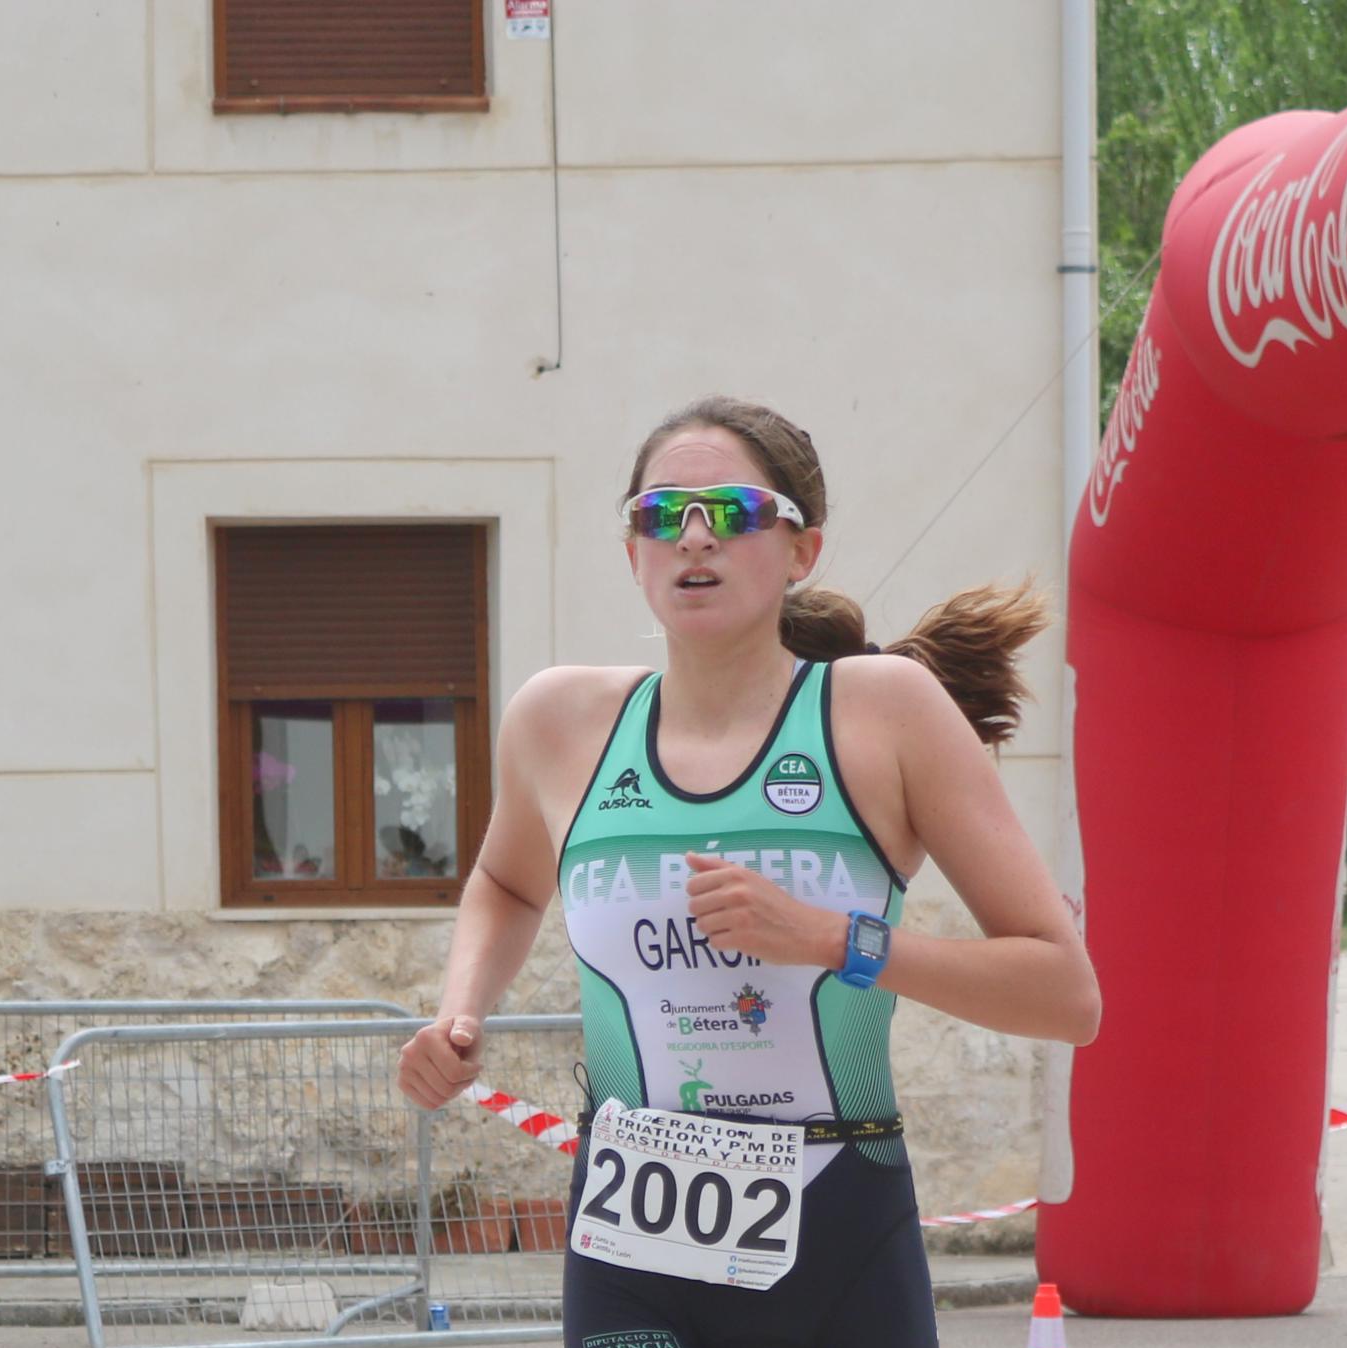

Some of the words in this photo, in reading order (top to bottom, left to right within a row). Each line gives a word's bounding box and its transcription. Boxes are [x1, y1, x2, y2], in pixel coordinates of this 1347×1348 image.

[779, 760, 808, 774] CEA
[777, 786, 810, 797] BÉTERA
[567, 853, 637, 903] CEA
[660, 999, 727, 1016] ajuntament
[678, 1016, 739, 1035] Bétera
[703, 1091, 795, 1107] PULGADAS
[617, 1117, 704, 1144] TRIATLON
[712, 1138, 722, 1147] Y
[773, 1143, 797, 1154] DE
[772, 1132, 798, 1143] DE
[615, 1129, 709, 1158] CASTILLA
[720, 1151, 730, 1161] Y
[743, 1154, 796, 1166] LEON
[582, 1147, 792, 1253] 2002
[586, 1333, 649, 1348] DIPUTACIÓ
